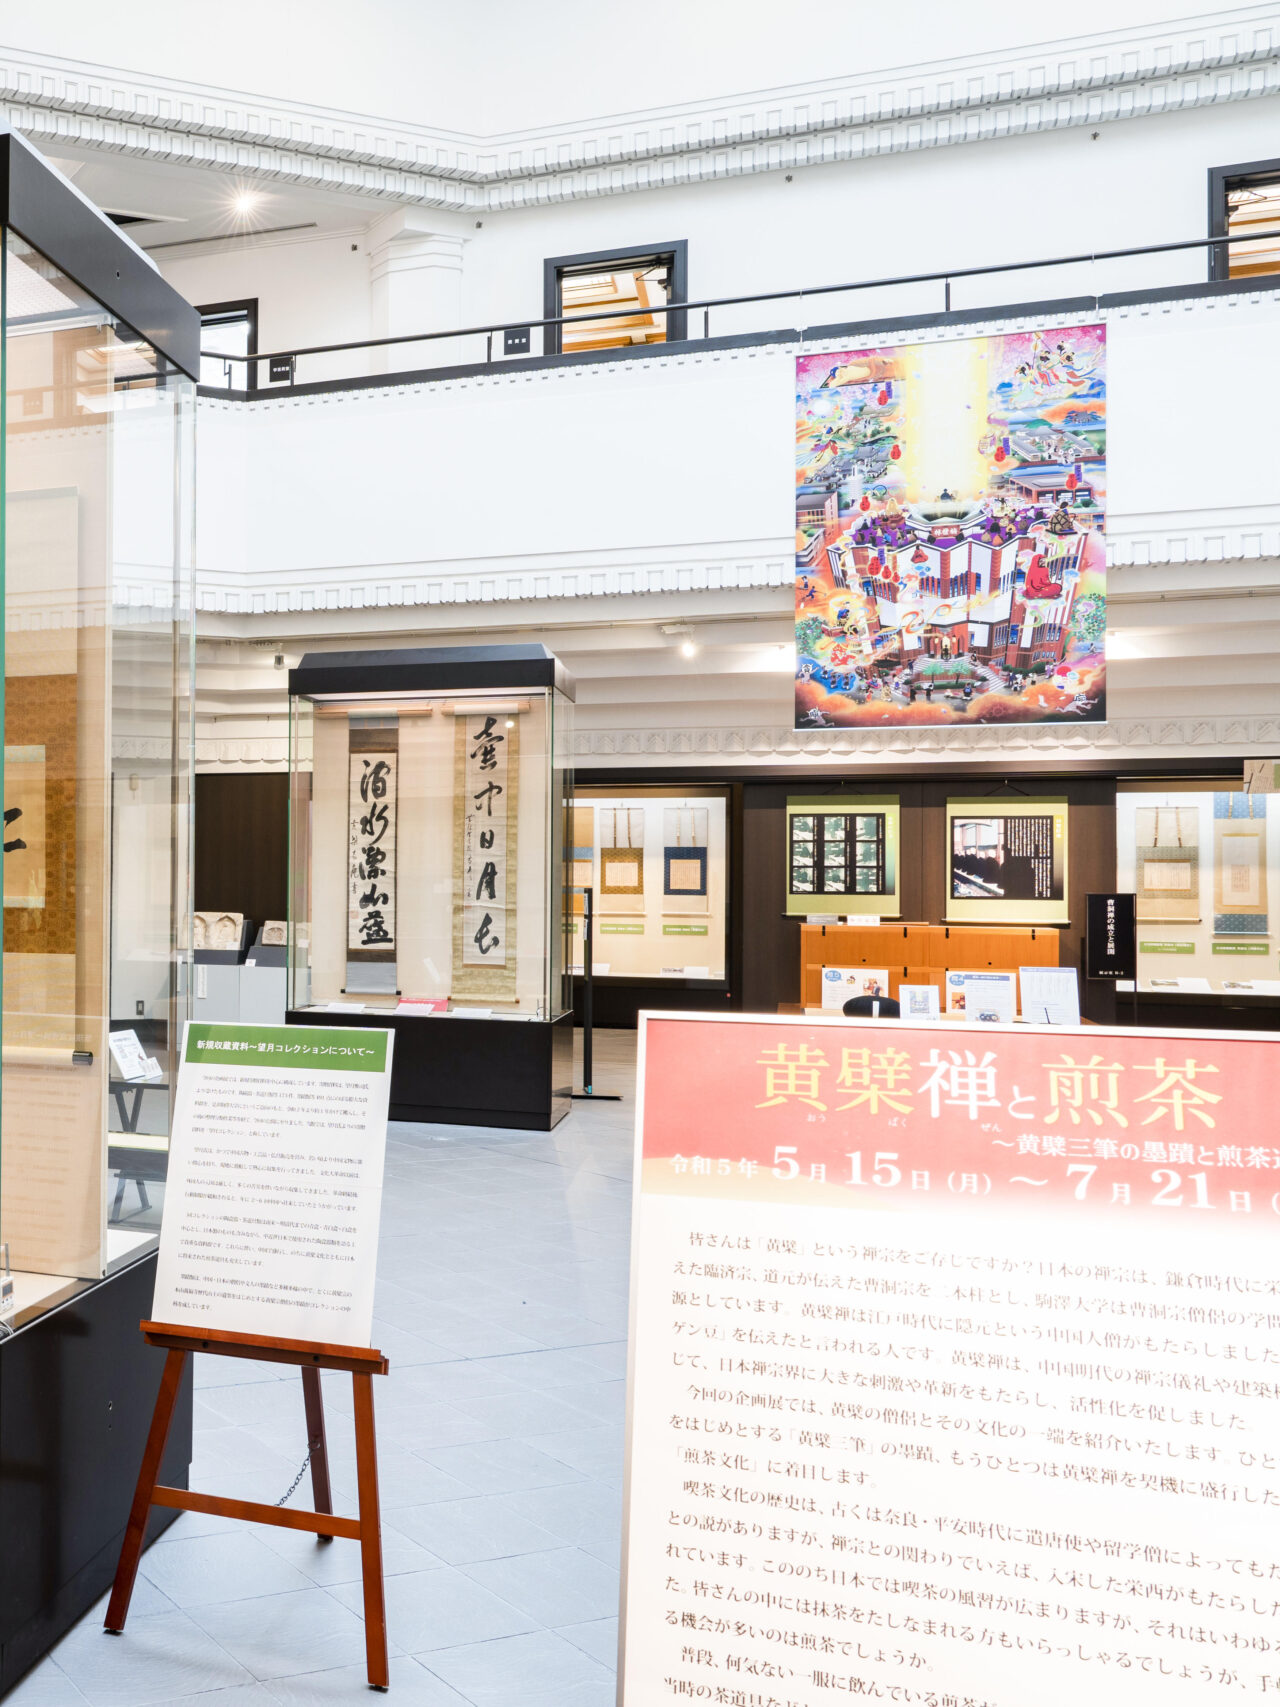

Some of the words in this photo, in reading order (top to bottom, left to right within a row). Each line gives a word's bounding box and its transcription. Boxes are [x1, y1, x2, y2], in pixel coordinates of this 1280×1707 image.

[196, 1039, 376, 1057] 新規収蔵資料～望月コレクションについて～
[671, 1320, 1280, 1400] ゲン豆」を伝えたと言われる人です。黄檗禅は、中国明代の禅宗儀礼や建築
[686, 1384, 1280, 1469] 今回の企画展では、黄檗の僧侶とその文化の一端を紹介いたします。ひと
[664, 1575, 1280, 1694] た。皆さんの中には抹茶をたしなまれる方もいらっしゃるでしょうが、手
